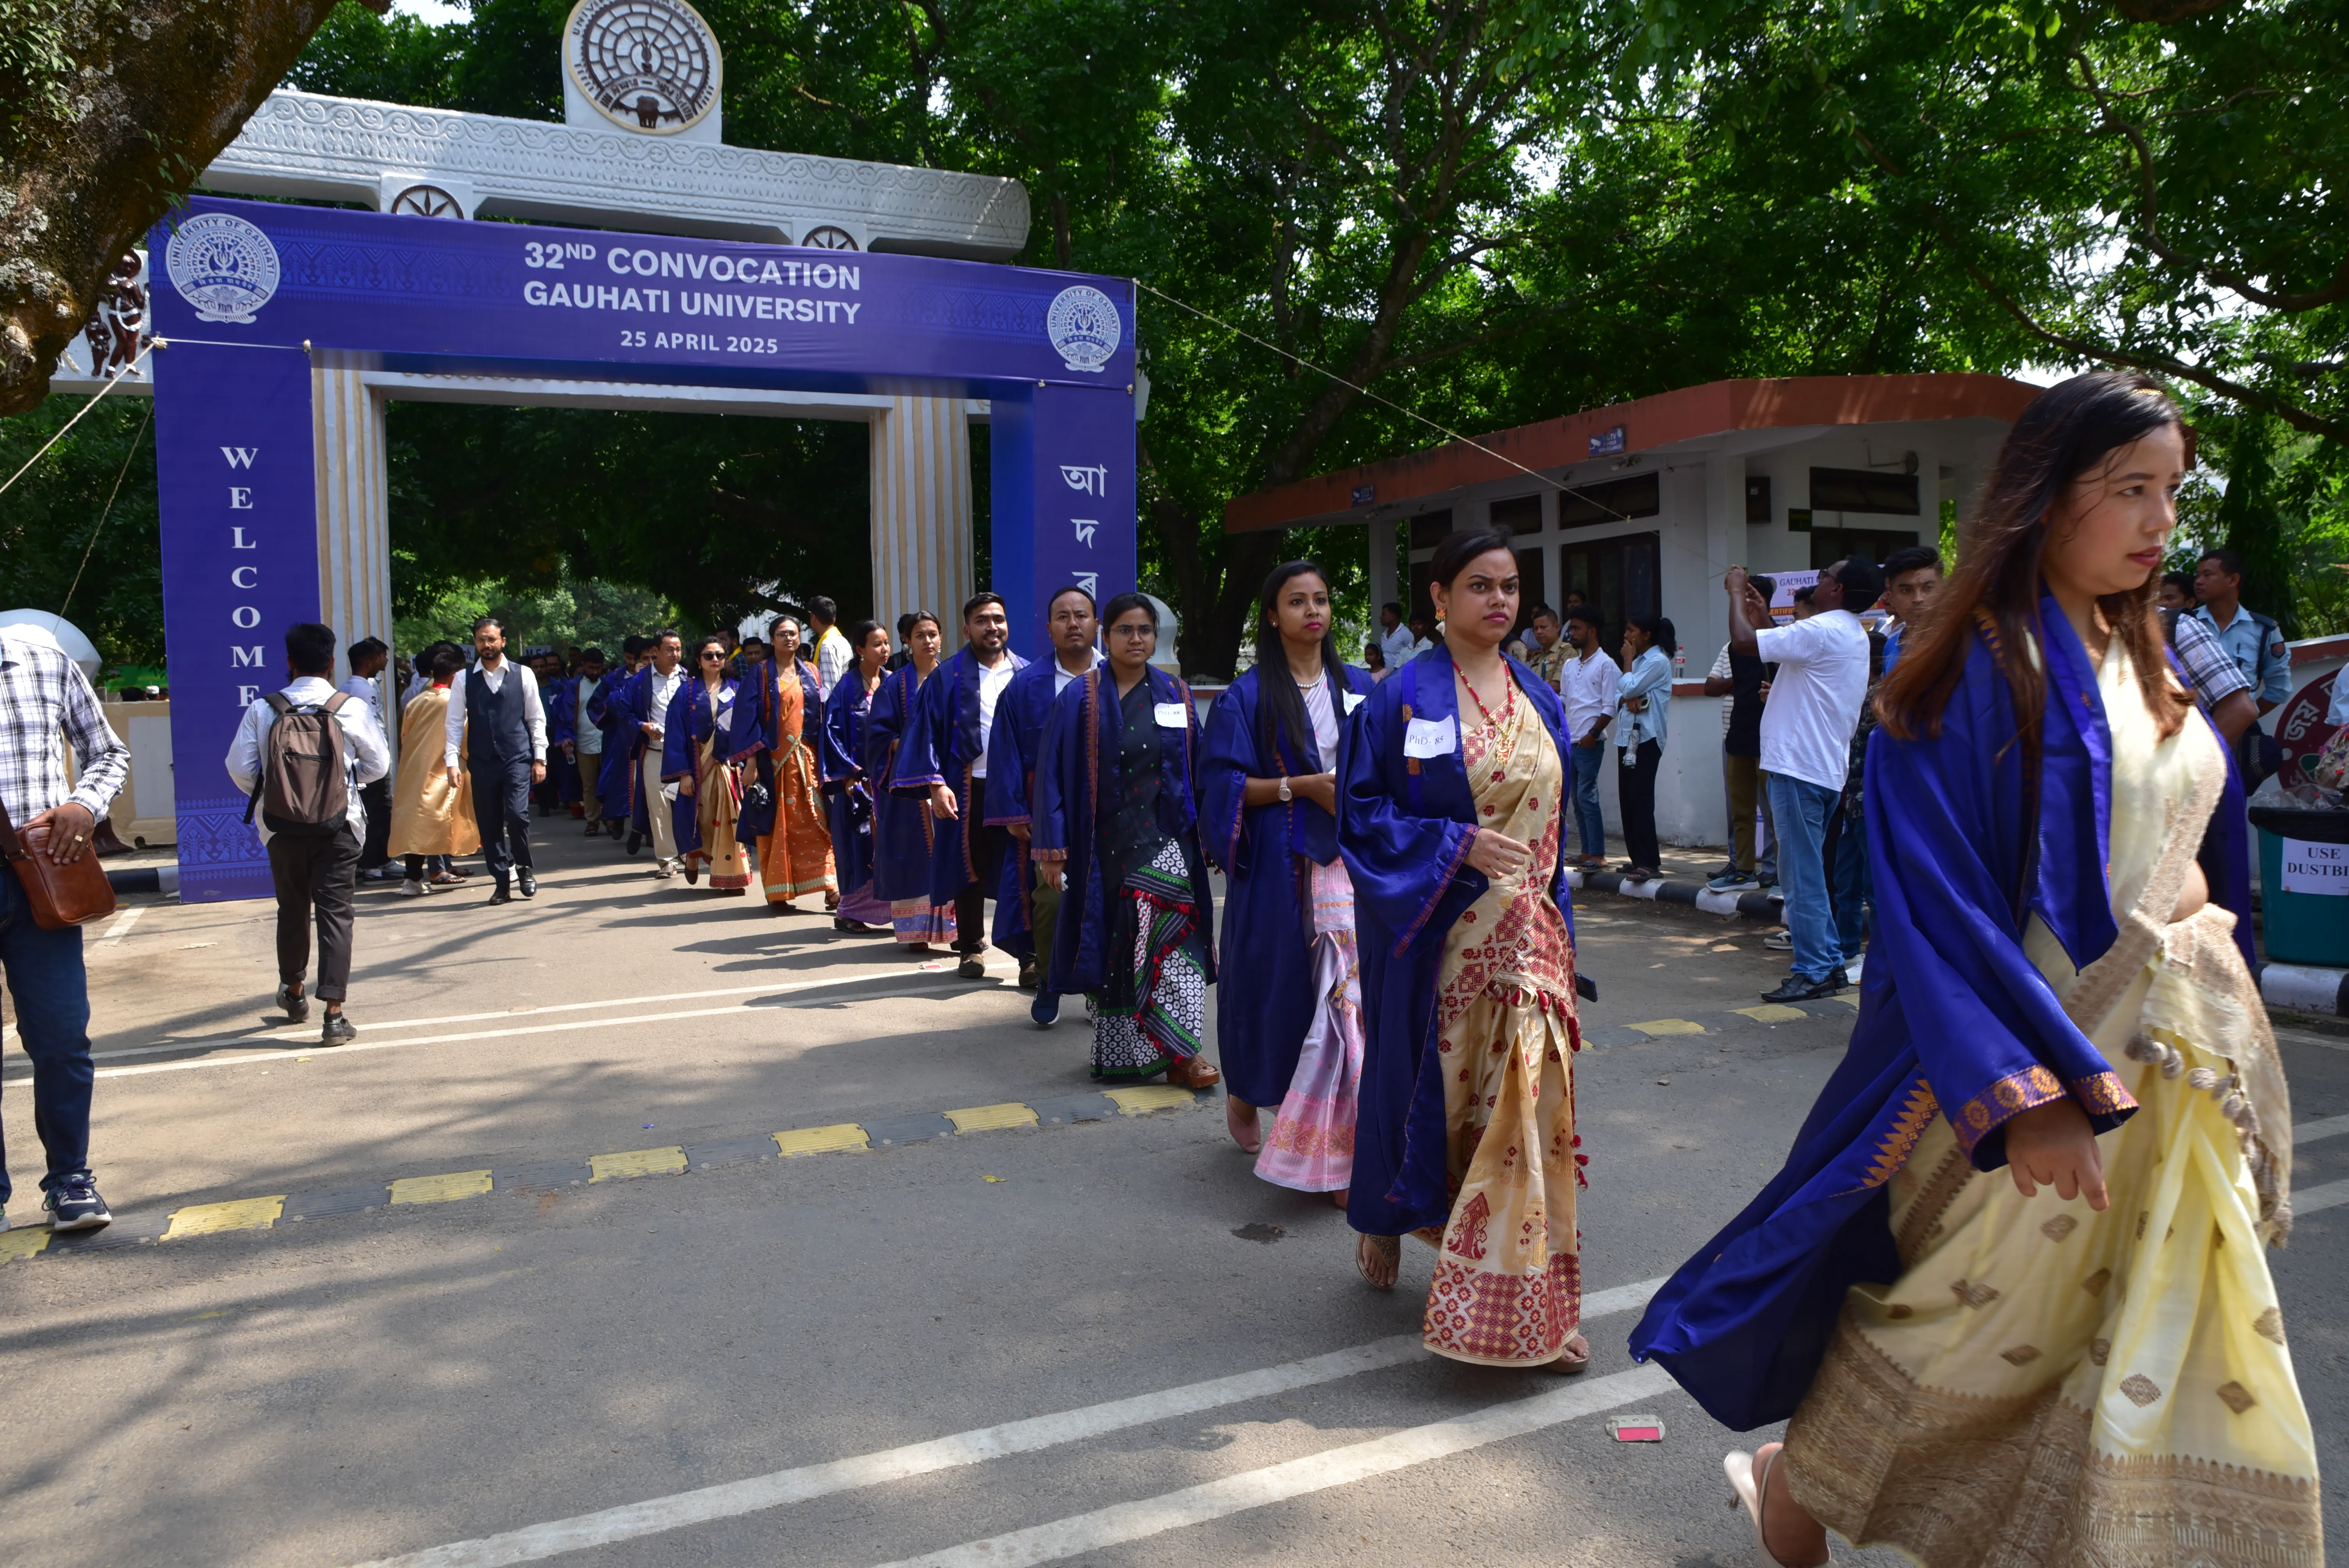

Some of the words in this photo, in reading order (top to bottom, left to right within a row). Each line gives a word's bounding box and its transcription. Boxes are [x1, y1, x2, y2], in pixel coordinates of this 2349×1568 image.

[173, 219, 219, 267] UNIVERSITY
[225, 220, 242, 228] OF
[245, 228, 275, 274] GAUHATI
[524, 242, 597, 269] 32ND
[607, 247, 860, 290] CONVOCATION
[524, 280, 670, 313] GAUHATI
[681, 291, 861, 324] UNIVERSITY
[1051, 289, 1082, 328] UNIVERSITY
[1098, 297, 1117, 333] GAUHATI
[621, 330, 647, 347] 25
[654, 332, 720, 351] APRIL
[727, 336, 778, 354] 2025
[219, 447, 266, 707] WELCOME
[1779, 576, 1814, 586] GAUHATI
[1435, 735, 1444, 745] 85
[2287, 862, 2349, 877] DUSTBI
[2308, 847, 2341, 859] USE
